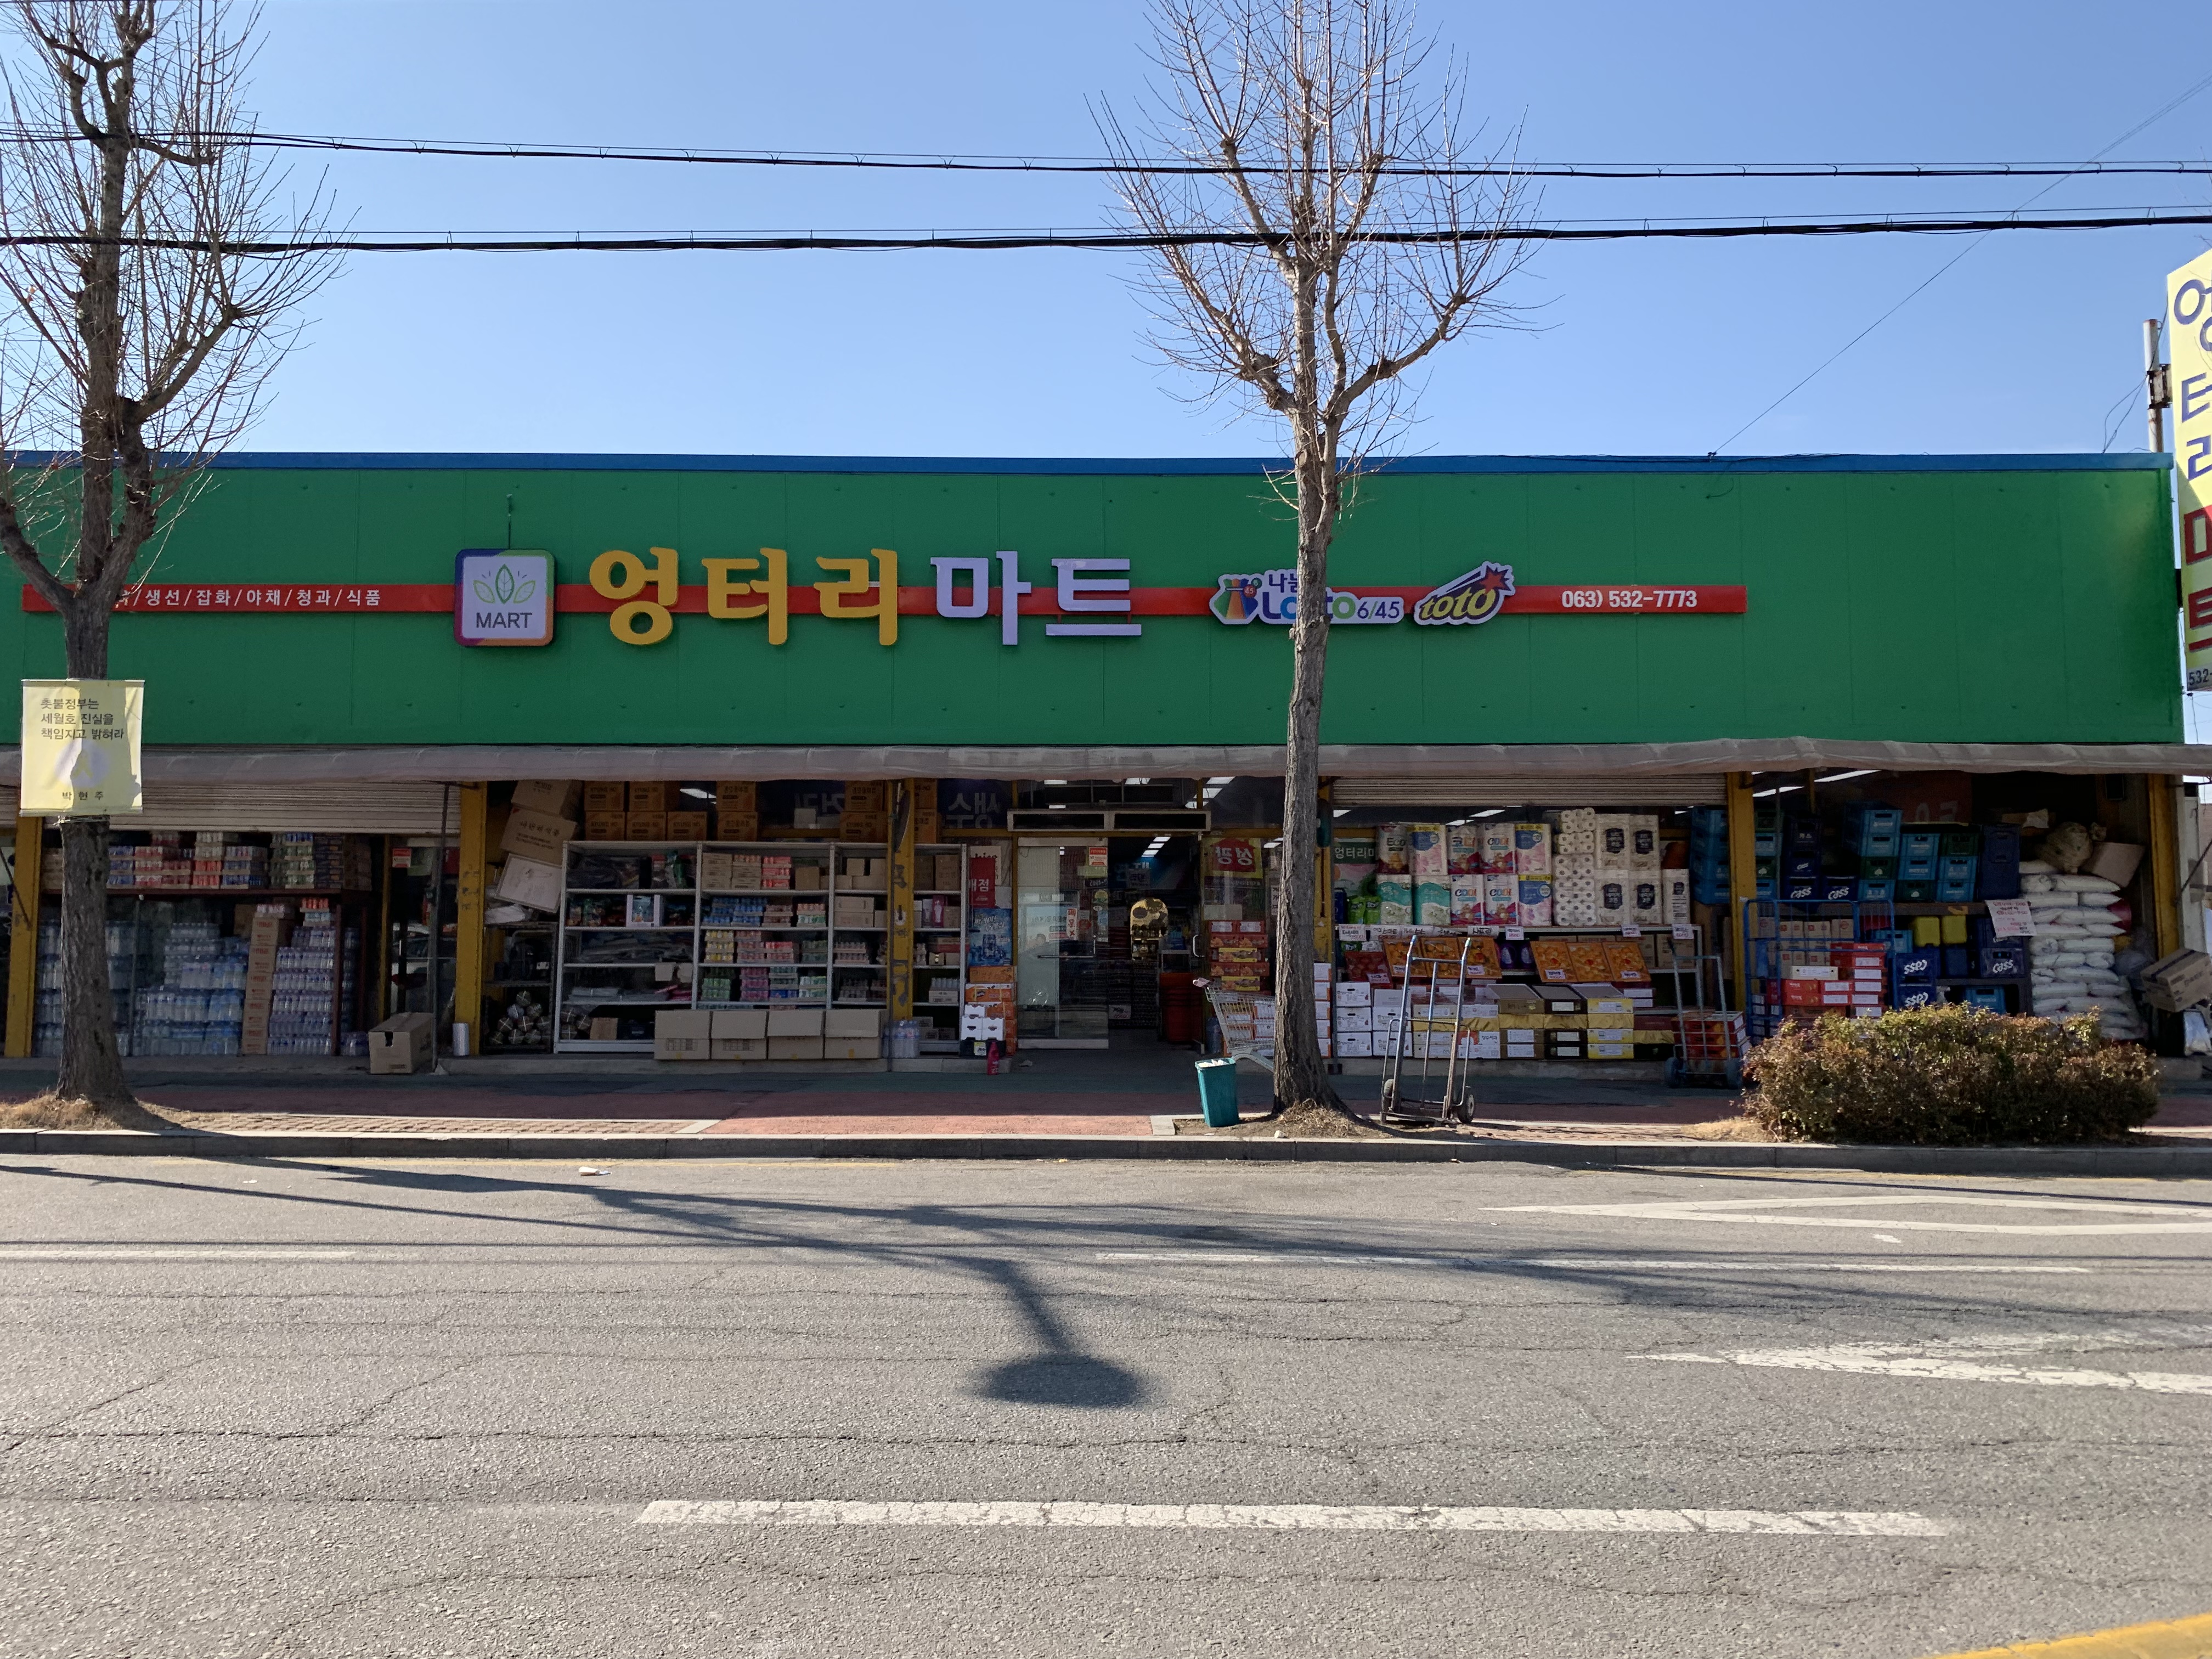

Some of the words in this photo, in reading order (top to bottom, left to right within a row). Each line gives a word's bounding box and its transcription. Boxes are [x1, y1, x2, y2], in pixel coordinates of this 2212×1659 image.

[1262, 591, 1355, 619] Loto
[1420, 587, 1497, 620] toto
[1561, 590, 1603, 608] 063)
[1609, 590, 1697, 608] 532-7773
[476, 612, 533, 629] MART
[41, 698, 99, 709] 촛불정부는
[41, 713, 76, 725] 세월호
[81, 713, 114, 725] 진실을
[41, 728, 87, 740] 책임지고
[92, 728, 124, 740] 밝혀라
